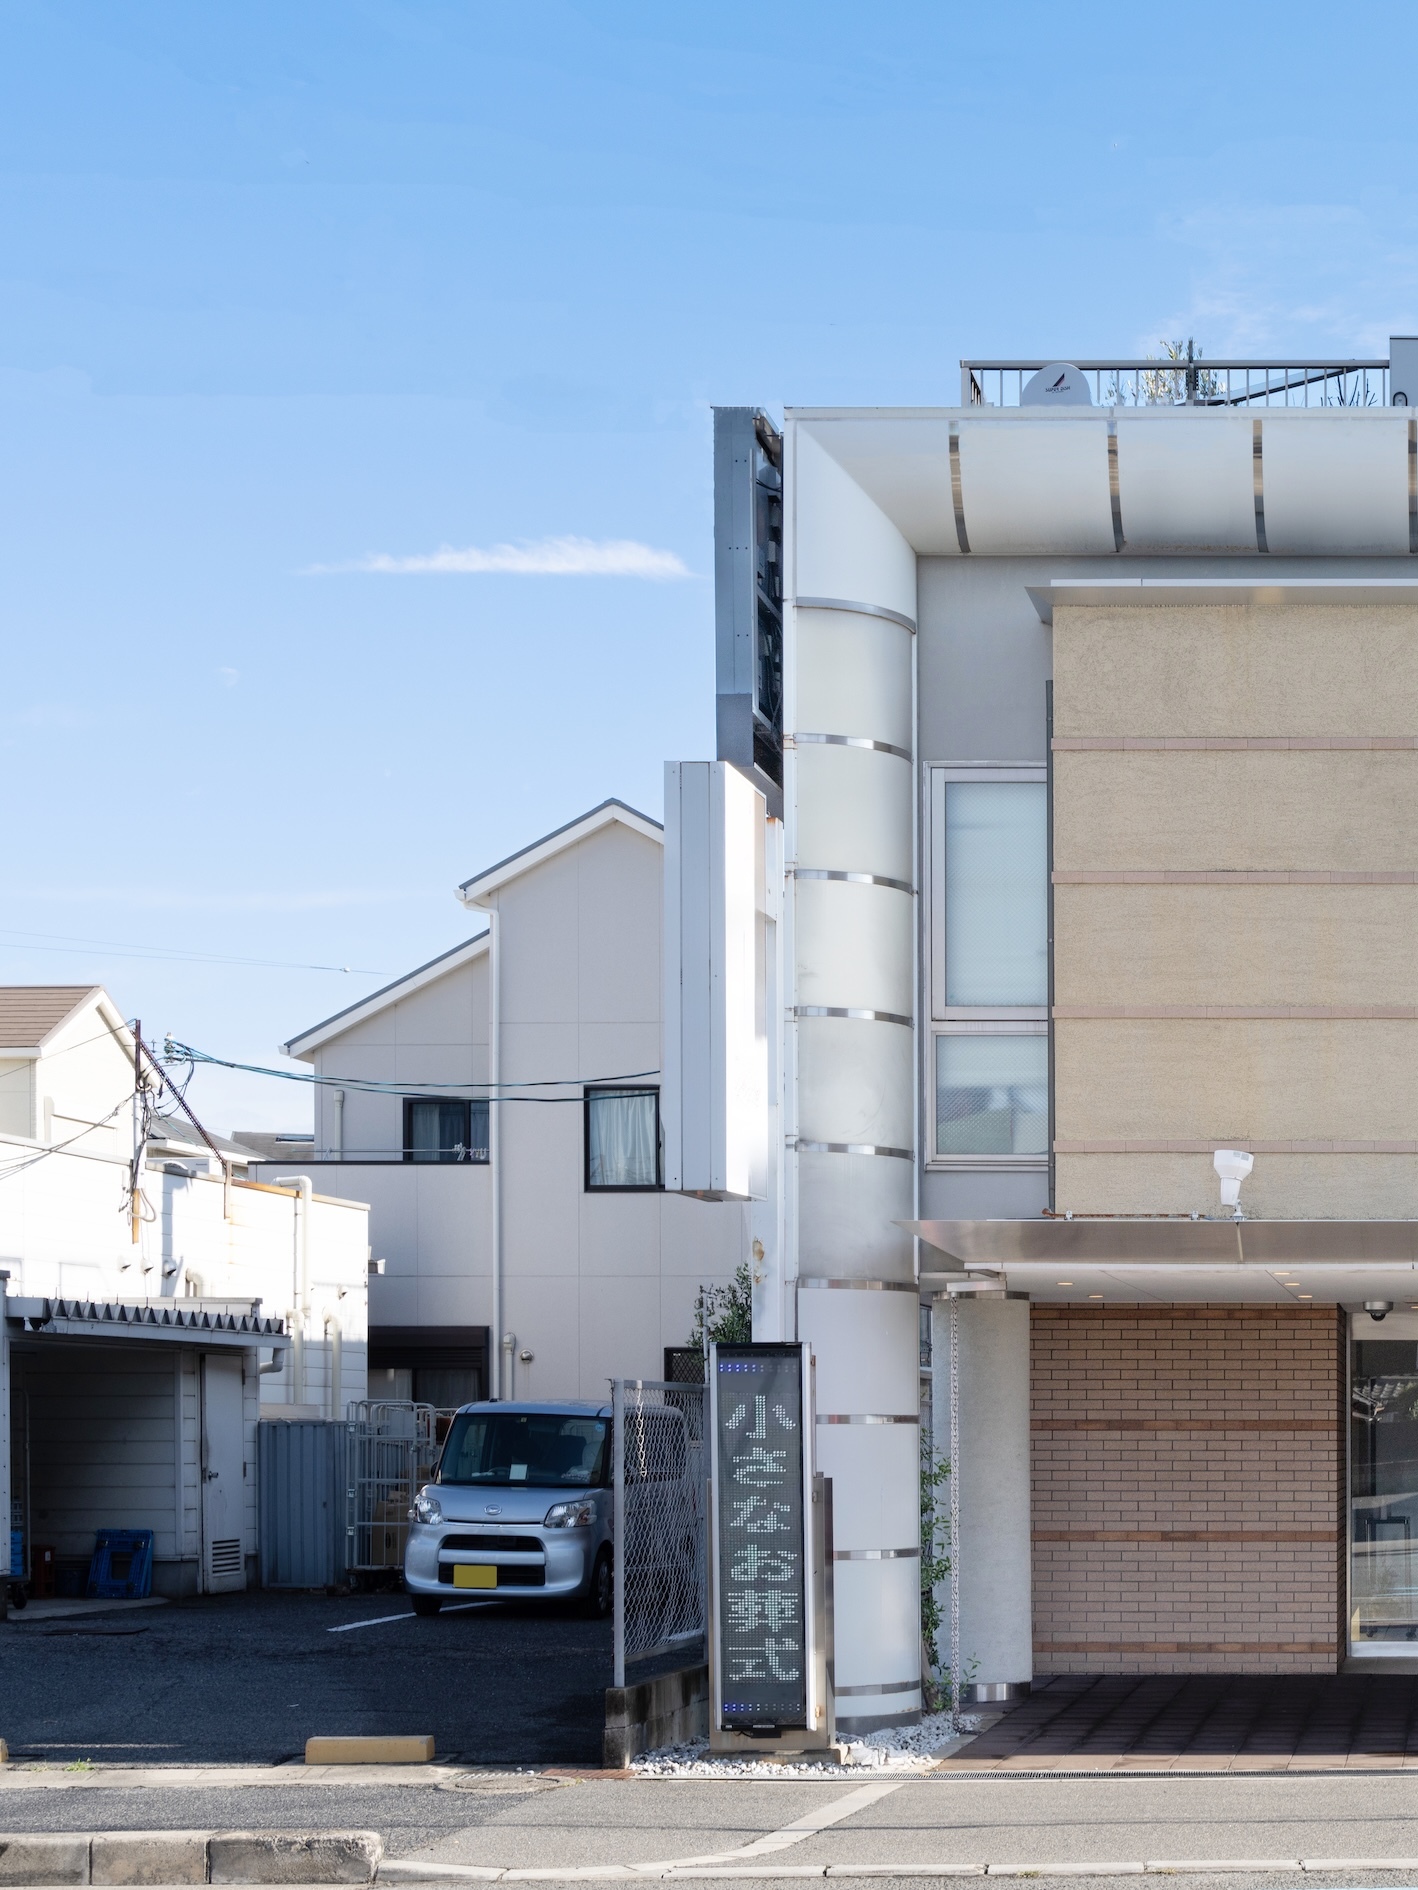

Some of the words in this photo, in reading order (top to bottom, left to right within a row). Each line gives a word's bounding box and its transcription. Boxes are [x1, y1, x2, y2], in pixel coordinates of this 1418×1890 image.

[725, 1395, 799, 1681] 小さなお葬式
